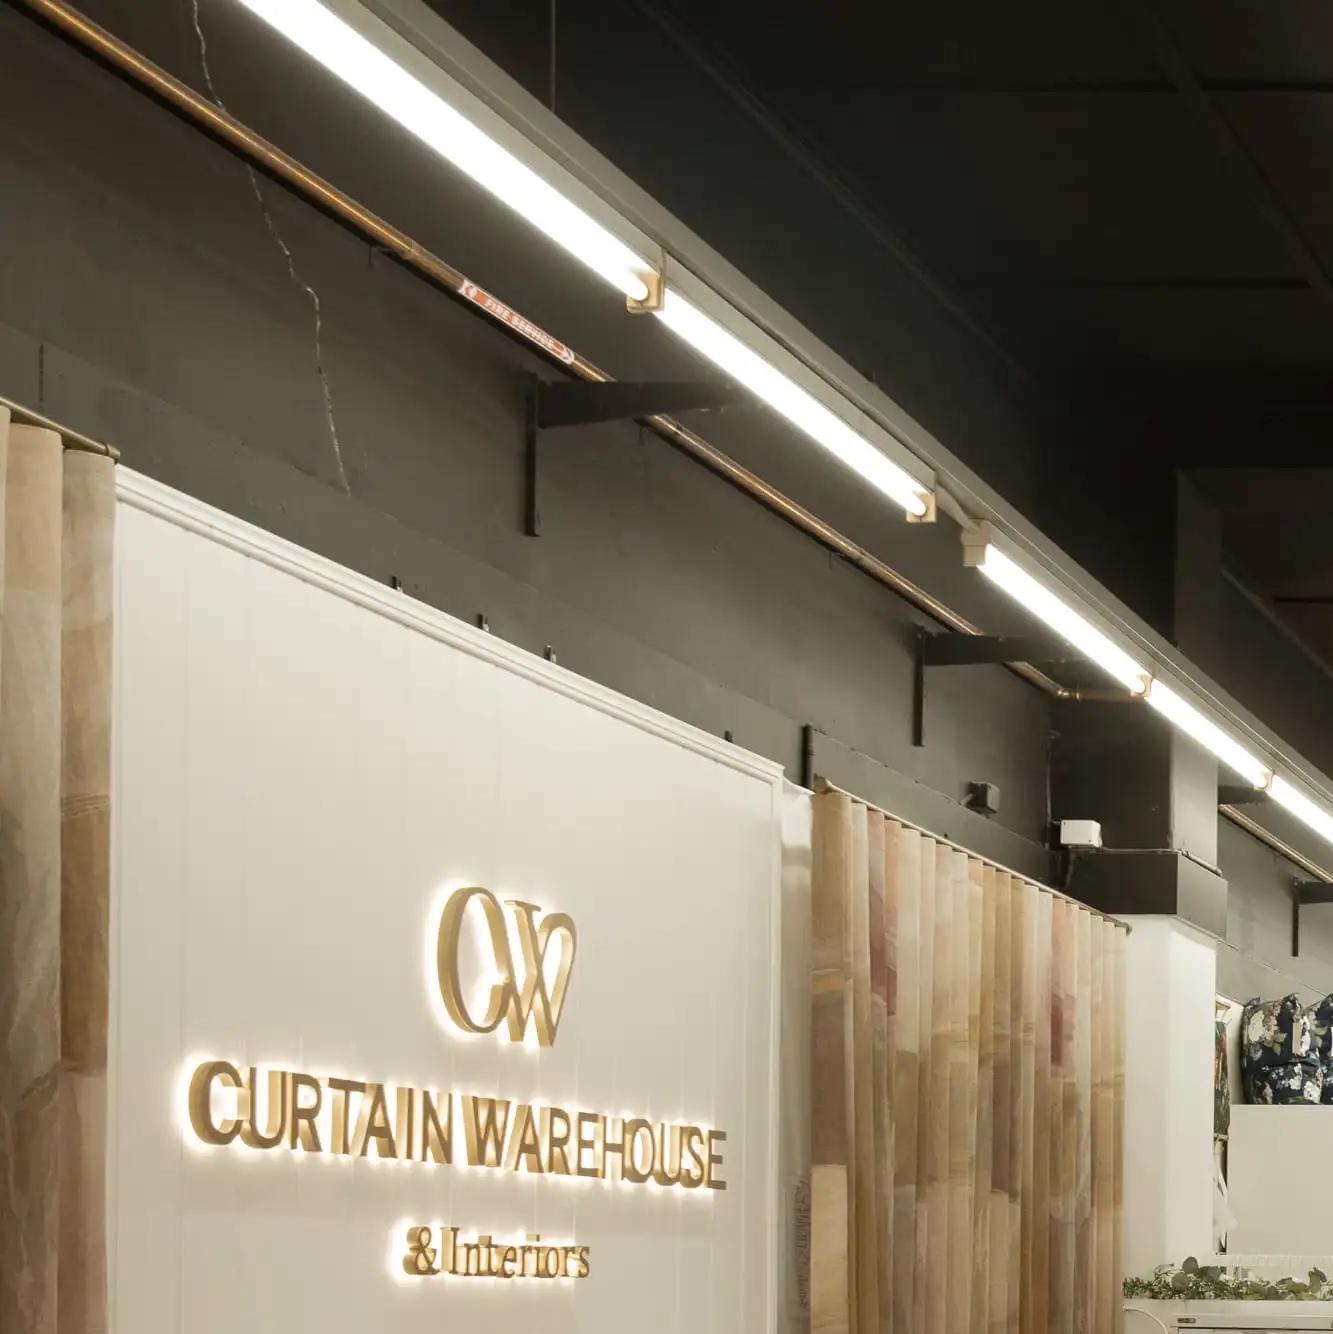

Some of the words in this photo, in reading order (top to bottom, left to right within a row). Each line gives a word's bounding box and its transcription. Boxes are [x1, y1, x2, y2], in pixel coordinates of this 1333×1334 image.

[484, 298, 512, 321] FIRE
[511, 314, 555, 350] SERVICE
[188, 1060, 454, 1165] CURTAIN
[463, 1095, 728, 1190] WAREHOUSE
[402, 1225, 441, 1277] &
[440, 1226, 591, 1279] Interiors
